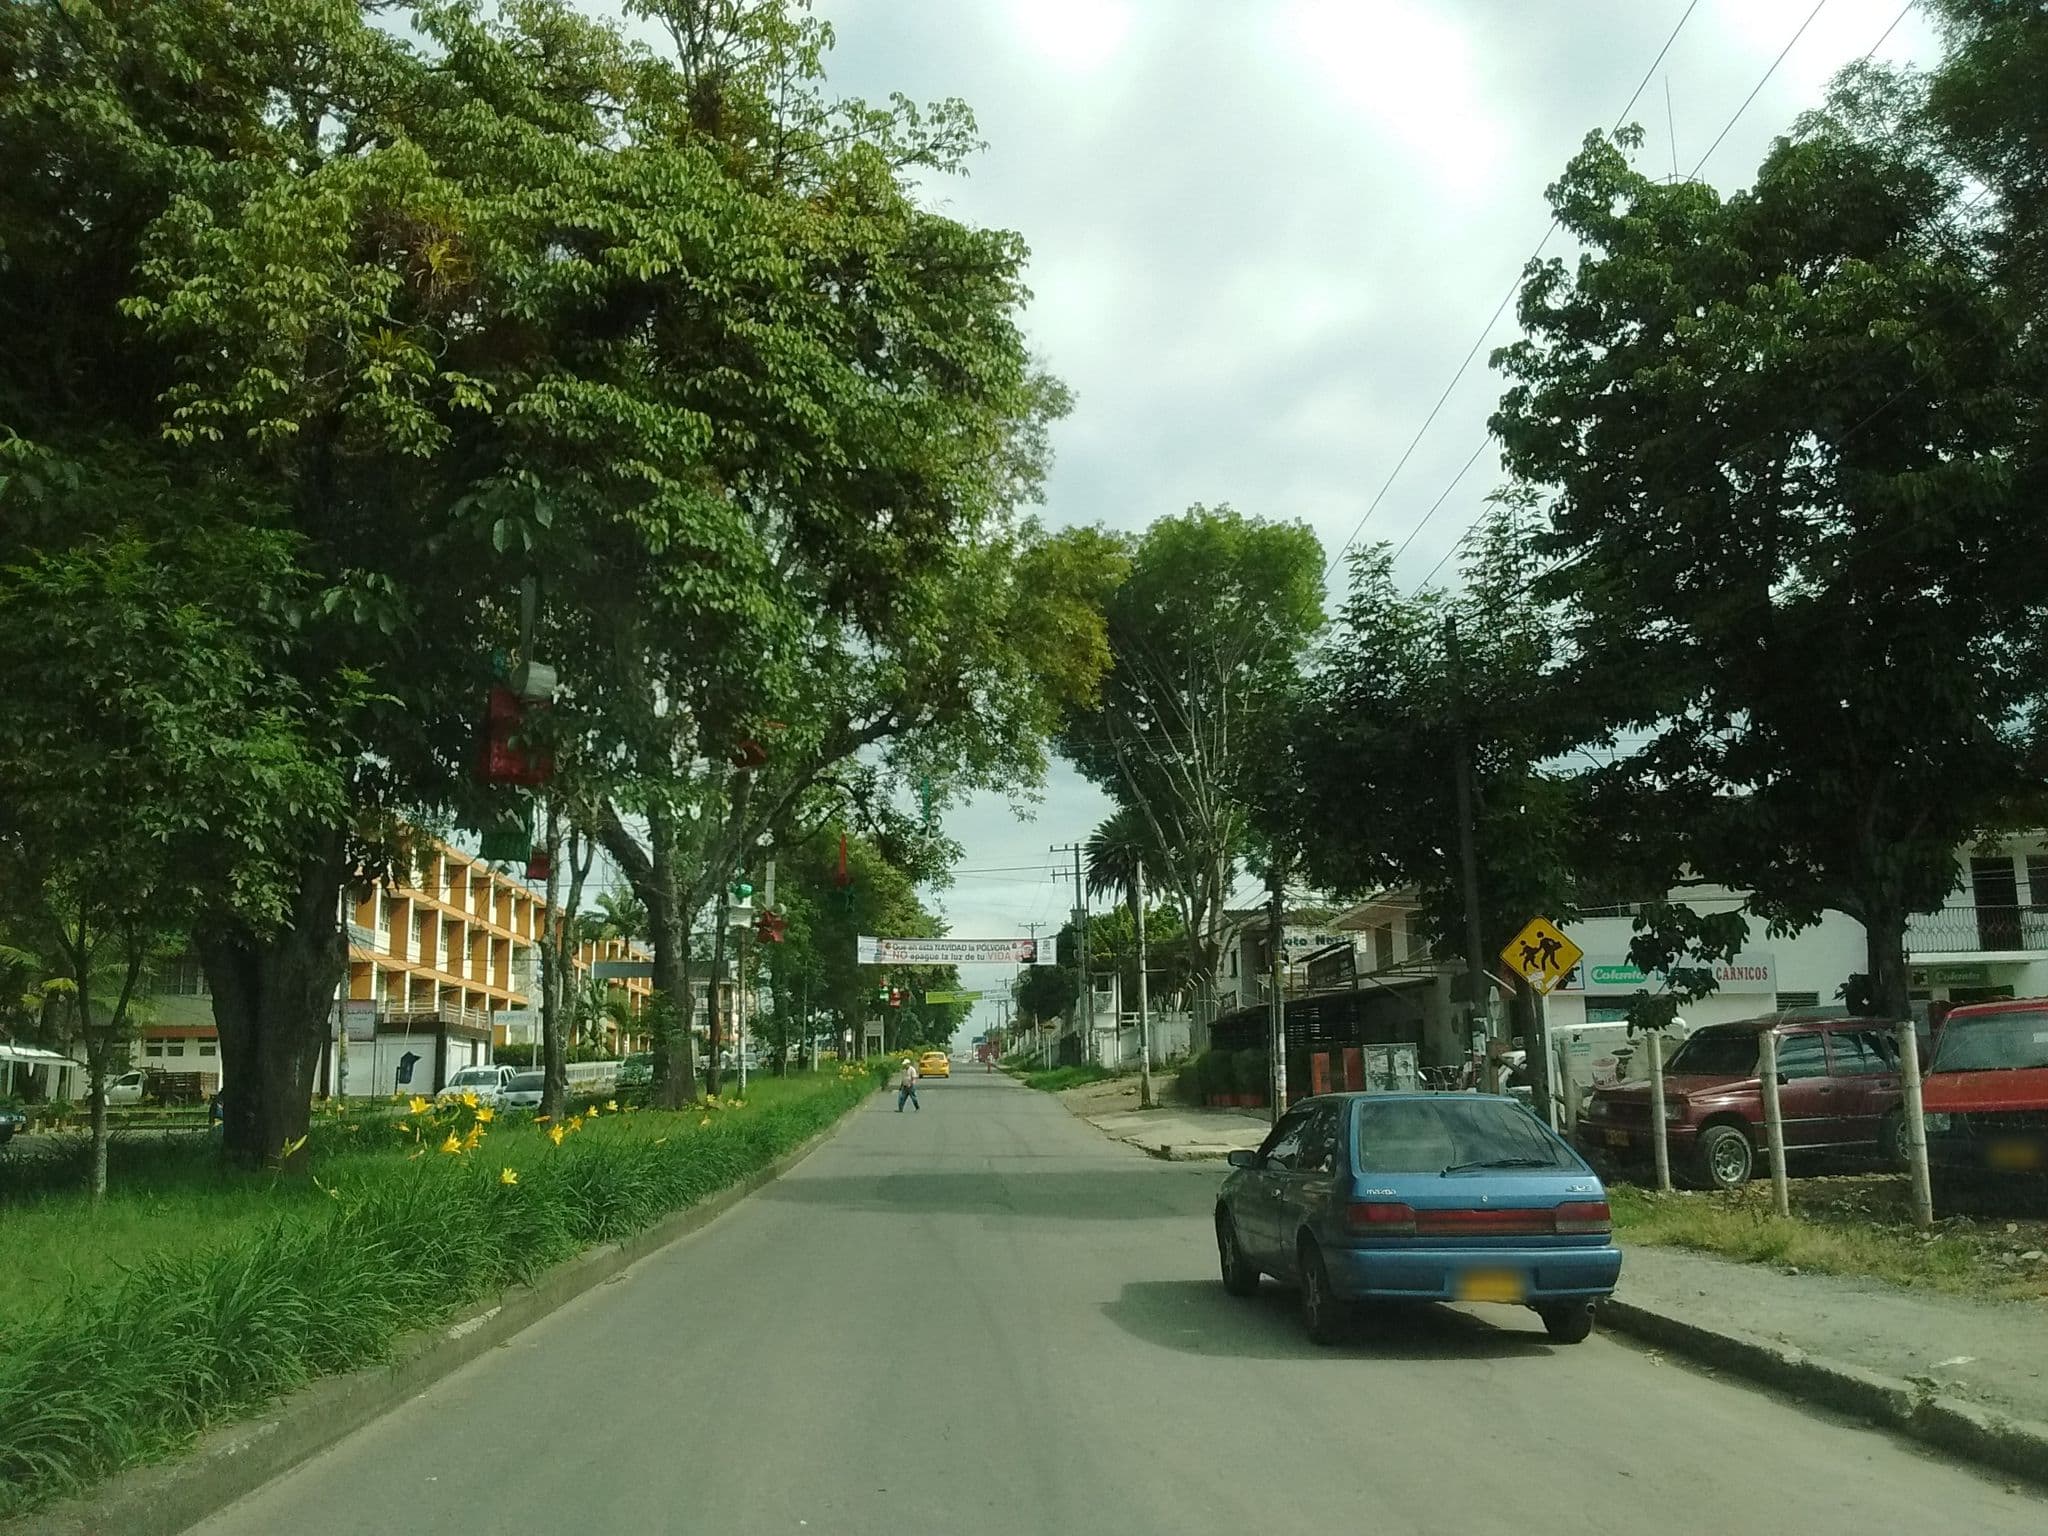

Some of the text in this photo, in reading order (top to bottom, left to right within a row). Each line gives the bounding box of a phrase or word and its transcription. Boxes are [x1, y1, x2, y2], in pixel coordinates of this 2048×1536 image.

[934, 943, 967, 951] NAVIDAD
[892, 951, 1011, 962] NO apague la luz de tu VIDA
[1715, 966, 1768, 981] CARNICOS
